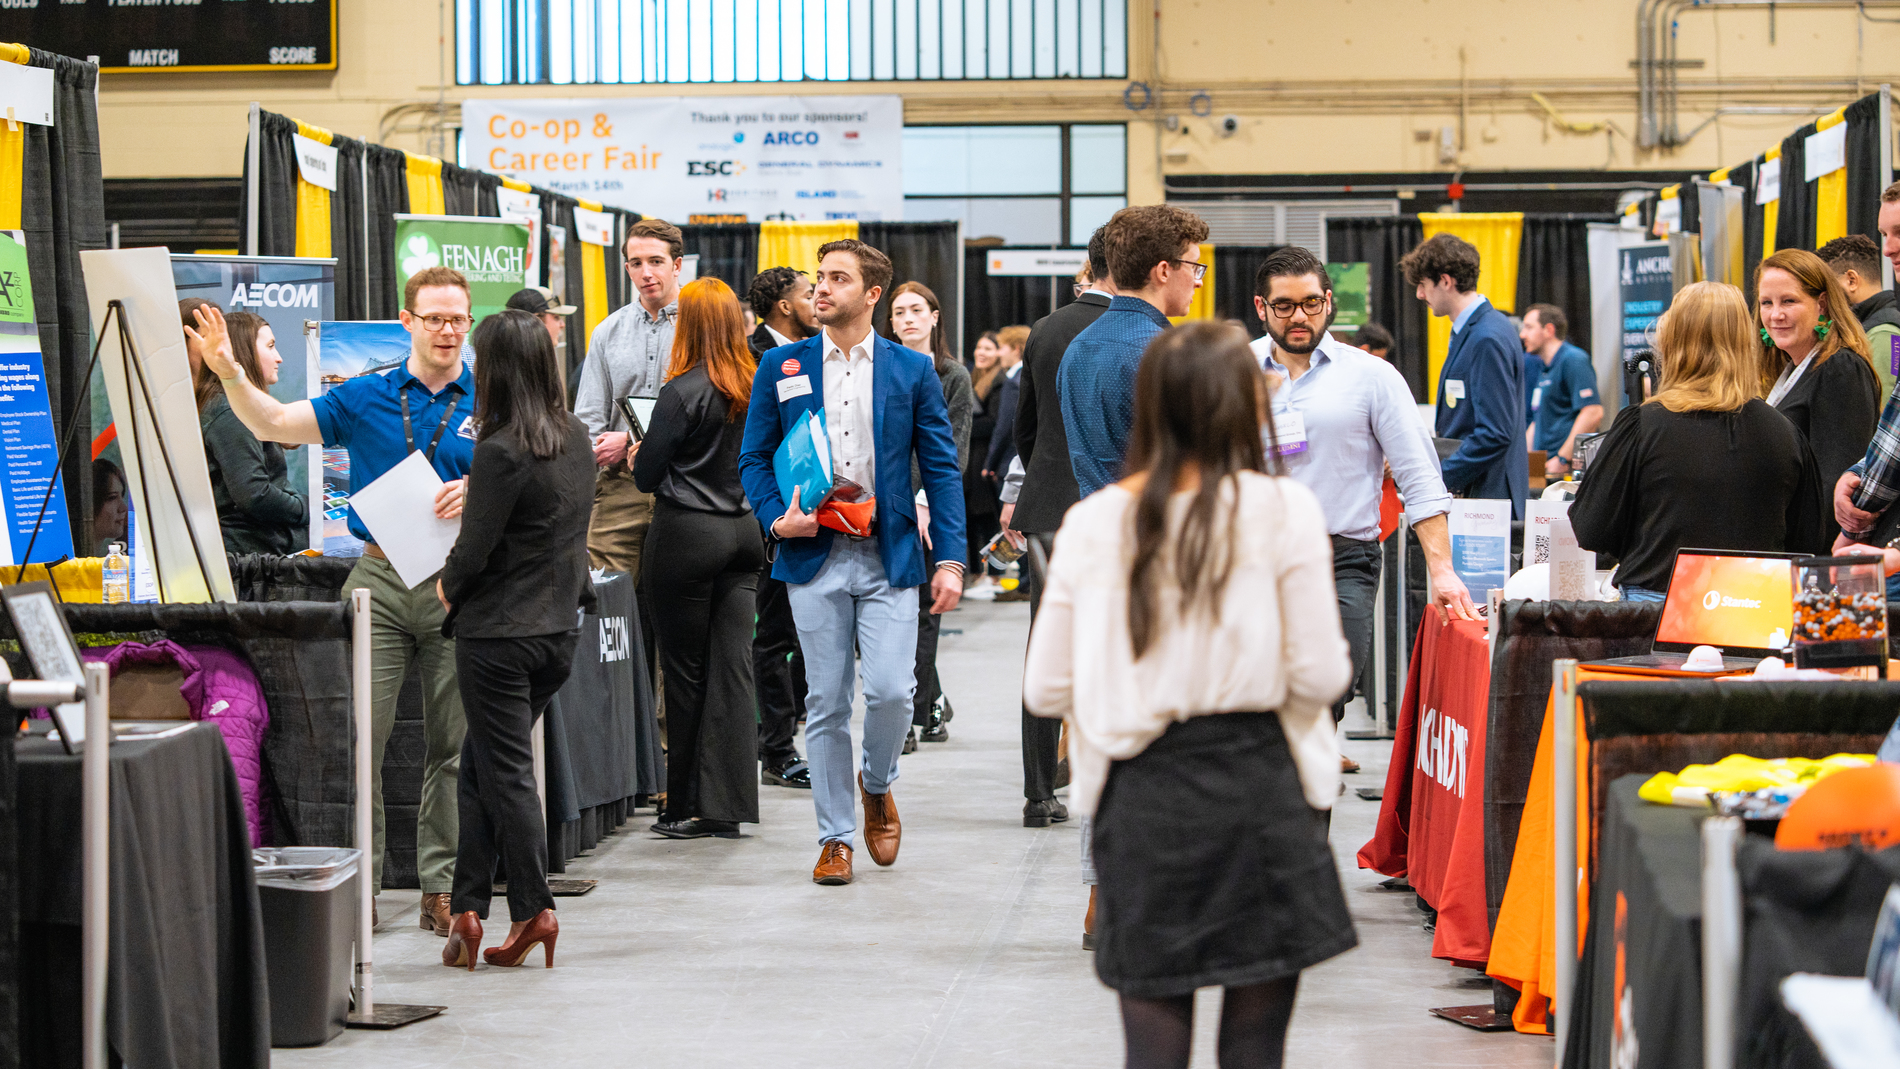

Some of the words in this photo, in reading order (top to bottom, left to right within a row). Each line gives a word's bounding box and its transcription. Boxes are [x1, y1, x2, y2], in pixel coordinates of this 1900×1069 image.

[129, 50, 179, 66] MATCH
[269, 47, 316, 64] SCORE
[691, 112, 731, 123] Thank
[736, 114, 758, 124] you
[762, 112, 775, 122] to
[779, 114, 800, 122] our
[805, 112, 868, 124] sponsors!
[488, 114, 580, 144] Co-op
[592, 113, 614, 138] &
[764, 131, 819, 145] ARCO
[488, 147, 592, 171] Career
[604, 144, 662, 170] Fair
[687, 161, 733, 176] ESC
[550, 181, 590, 191] March
[595, 181, 624, 191] 14th
[442, 244, 524, 272] FENAGH
[14, 272, 23, 307] CORP
[229, 282, 318, 308] AECOM
[25, 373, 39, 381] along
[11, 383, 35, 392] following
[1276, 443, 1301, 453] LUMNI
[1464, 512, 1495, 520] RICHMOND
[1721, 595, 1762, 609] Stantec
